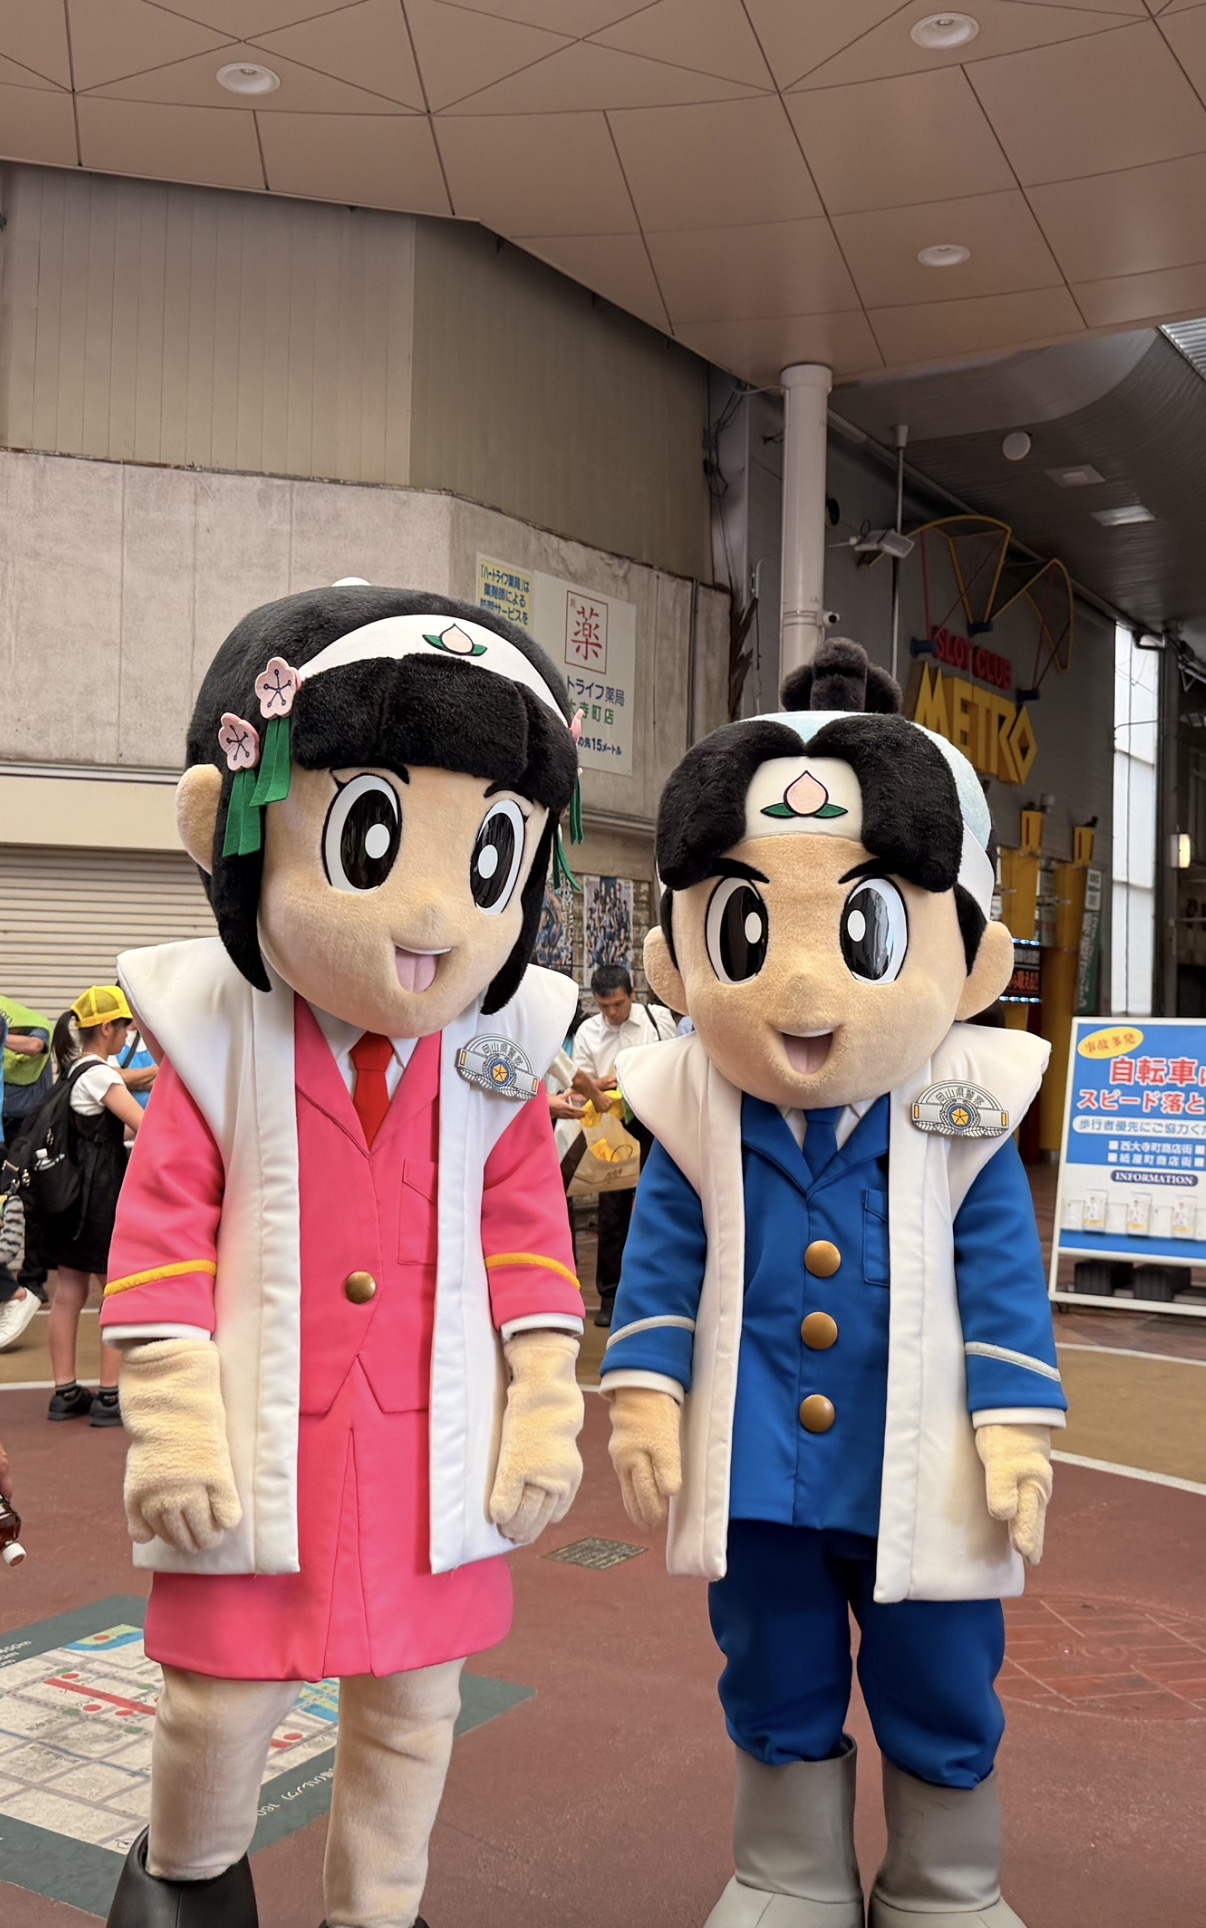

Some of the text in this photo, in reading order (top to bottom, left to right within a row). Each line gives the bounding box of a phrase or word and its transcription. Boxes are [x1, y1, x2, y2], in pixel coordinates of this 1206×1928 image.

[571, 606, 603, 661] 薬
[974, 645, 1012, 690] CLUB
[912, 661, 1039, 785] METRO
[1078, 1089, 1205, 1114] スピード落と
[1115, 1171, 1194, 1185] INFORMATION
